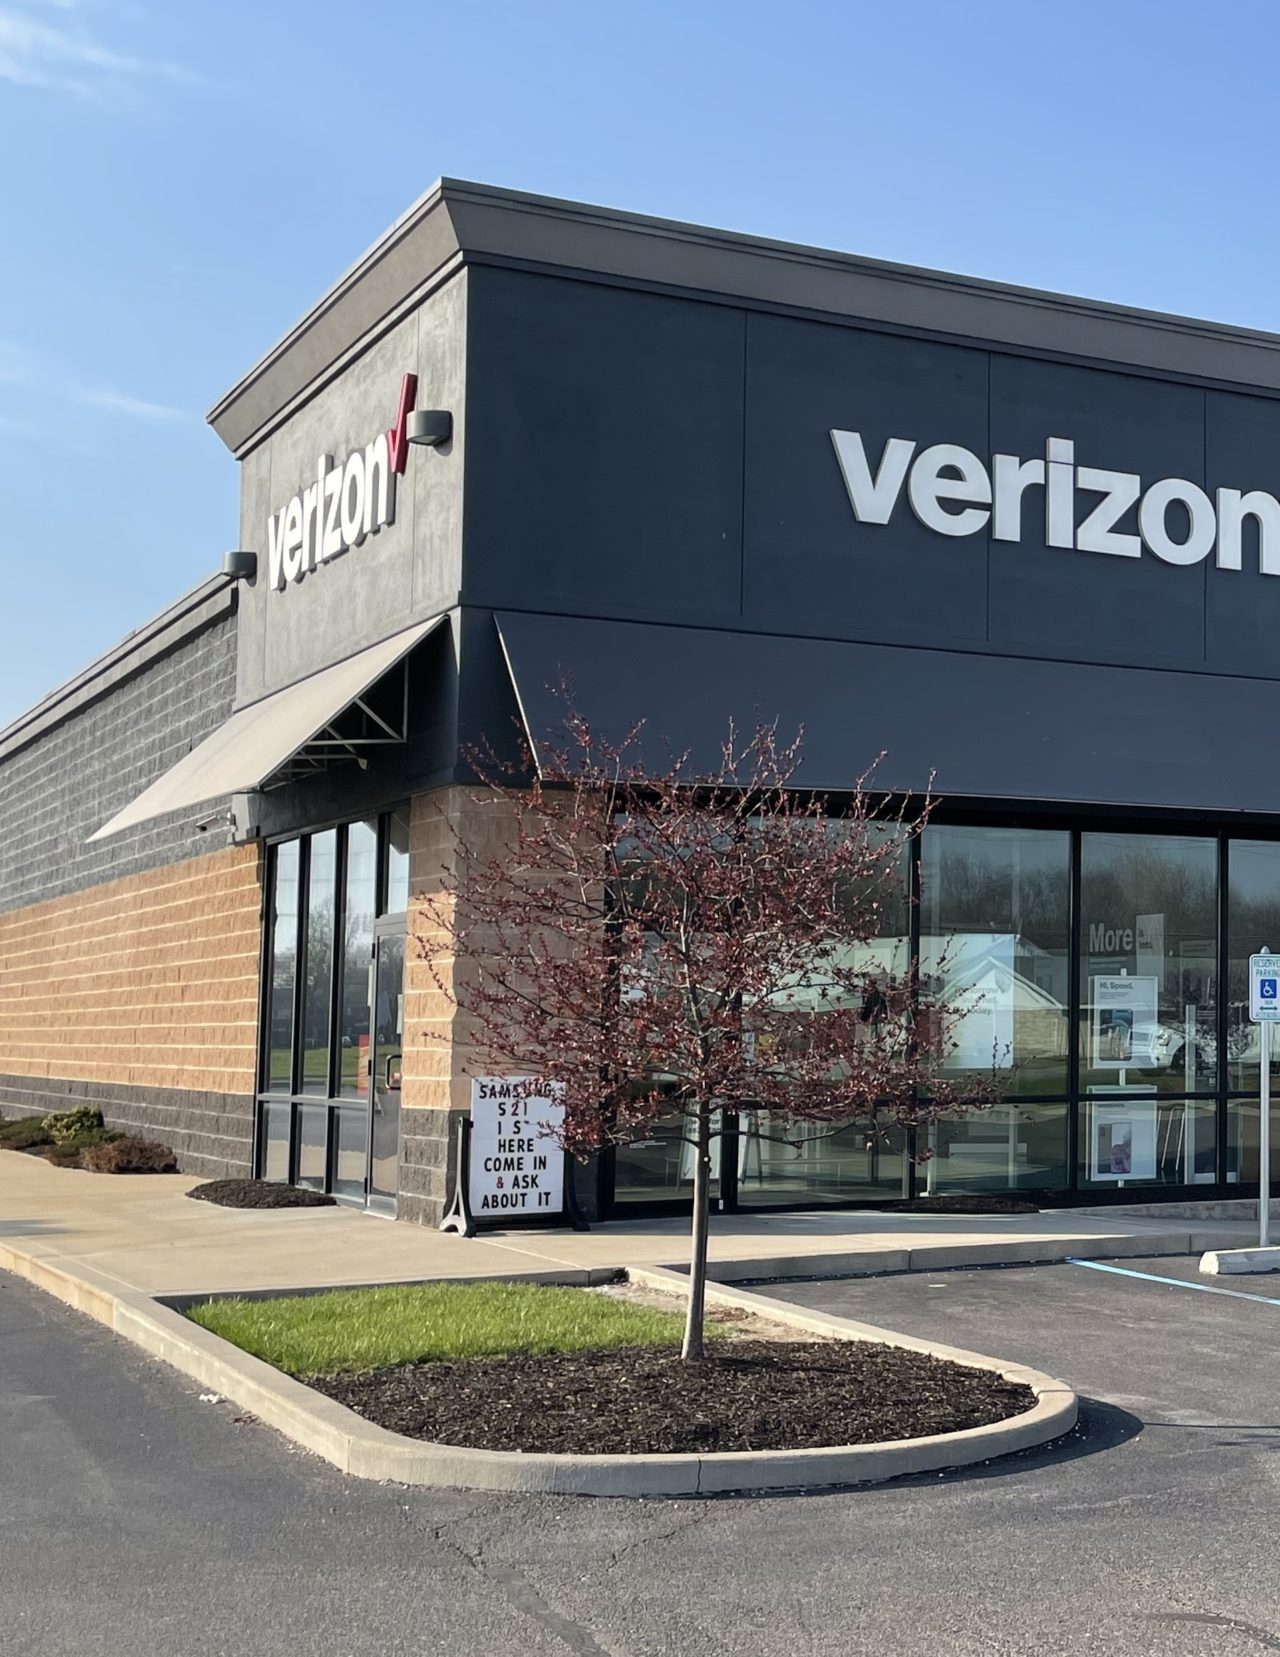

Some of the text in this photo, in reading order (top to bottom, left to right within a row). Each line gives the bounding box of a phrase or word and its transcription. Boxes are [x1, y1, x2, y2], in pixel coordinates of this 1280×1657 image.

[268, 433, 395, 592] verizon
[1089, 922, 1134, 952] More
[498, 1102, 528, 1116] S21
[498, 1138, 534, 1153] HERE
[484, 1156, 547, 1172] COME IN
[496, 1175, 539, 1189] & ASK
[481, 1192, 551, 1209] ABOUT IT
